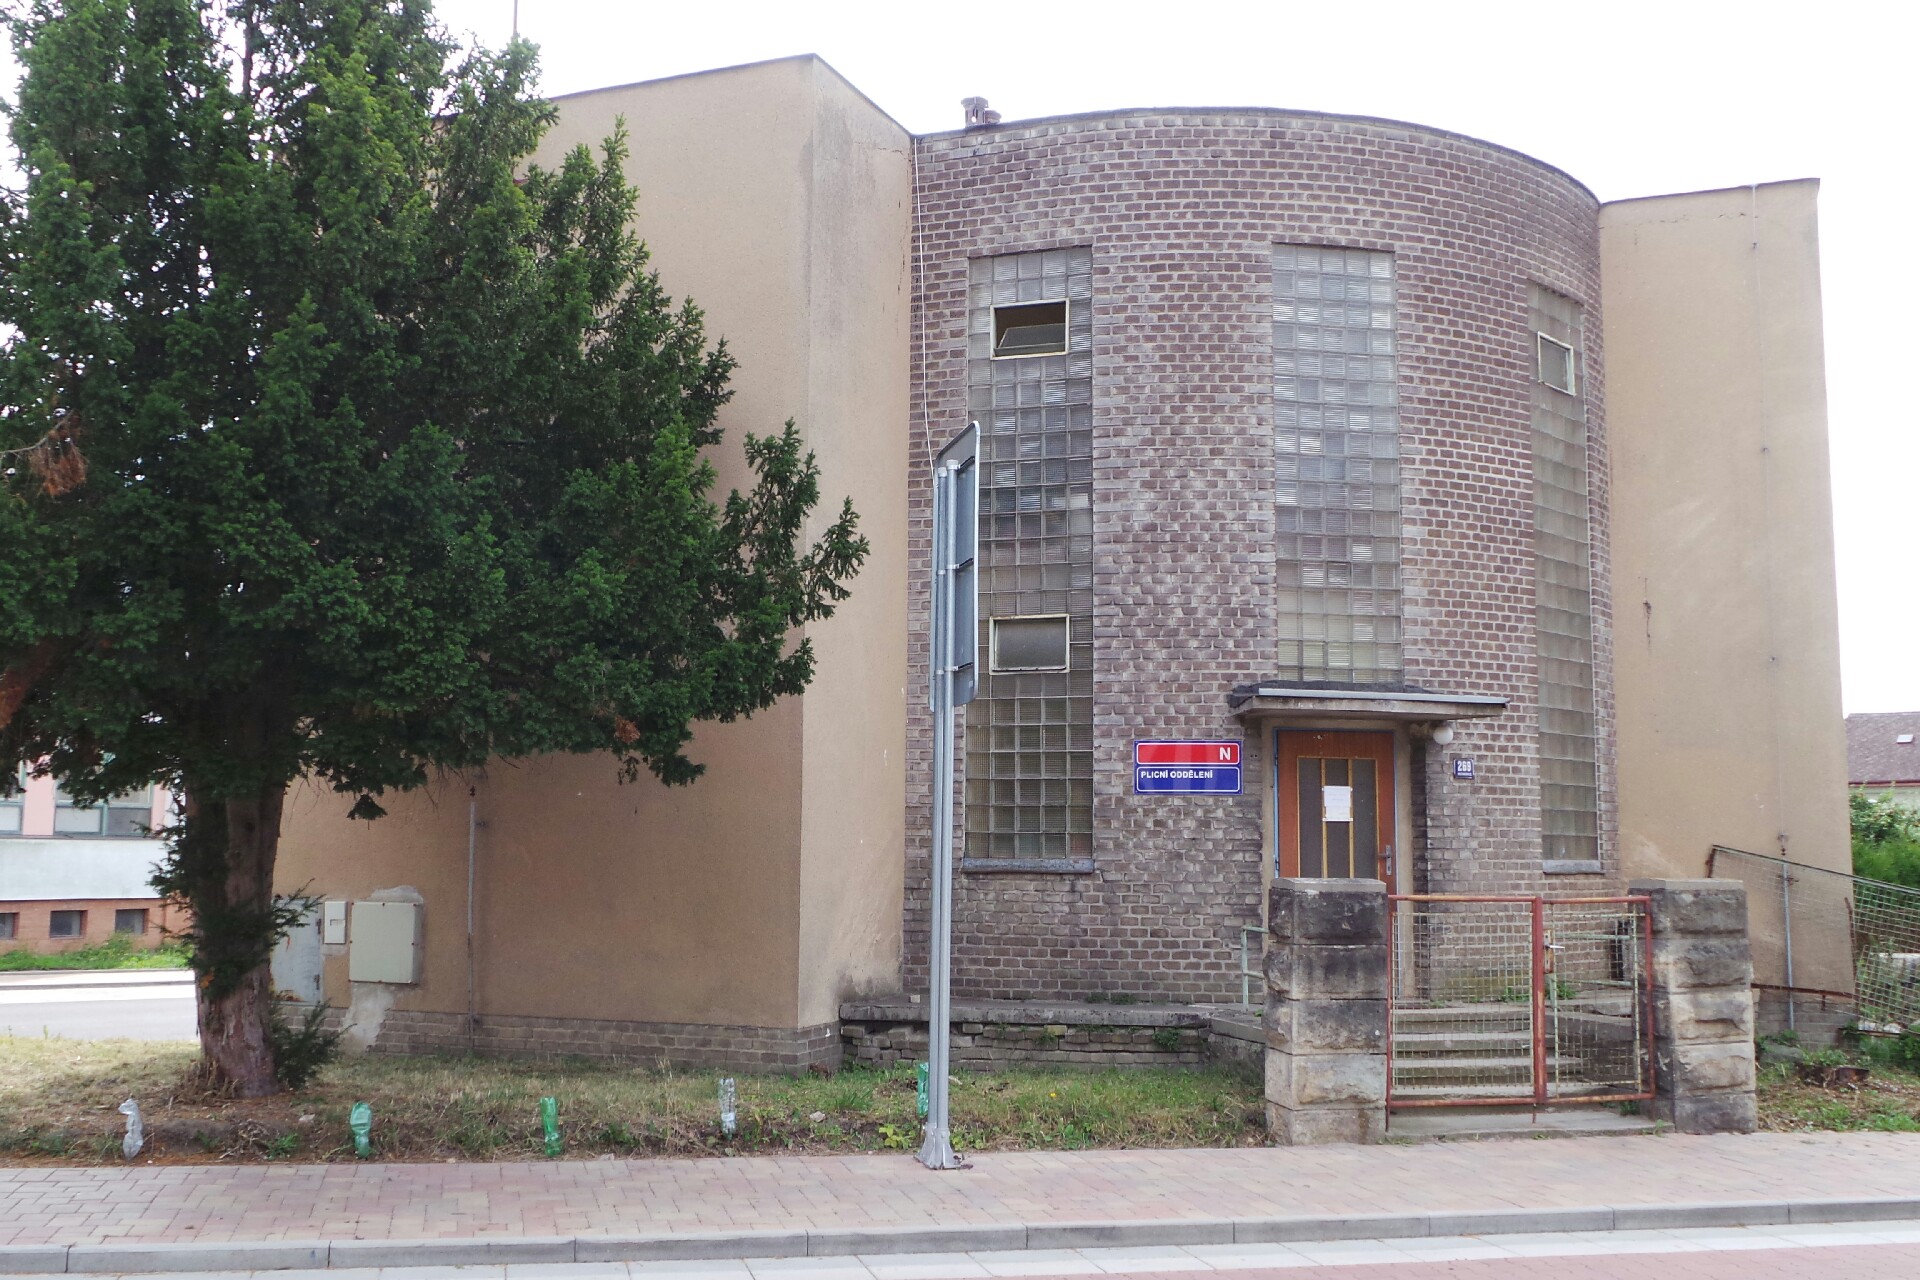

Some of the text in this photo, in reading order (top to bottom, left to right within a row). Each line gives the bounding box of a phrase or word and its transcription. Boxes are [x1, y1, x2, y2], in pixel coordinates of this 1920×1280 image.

[1219, 747, 1231, 760] N
[1458, 760, 1471, 771] 269
[1141, 770, 1213, 779] PLICNÍ ODDĚLENÍ
